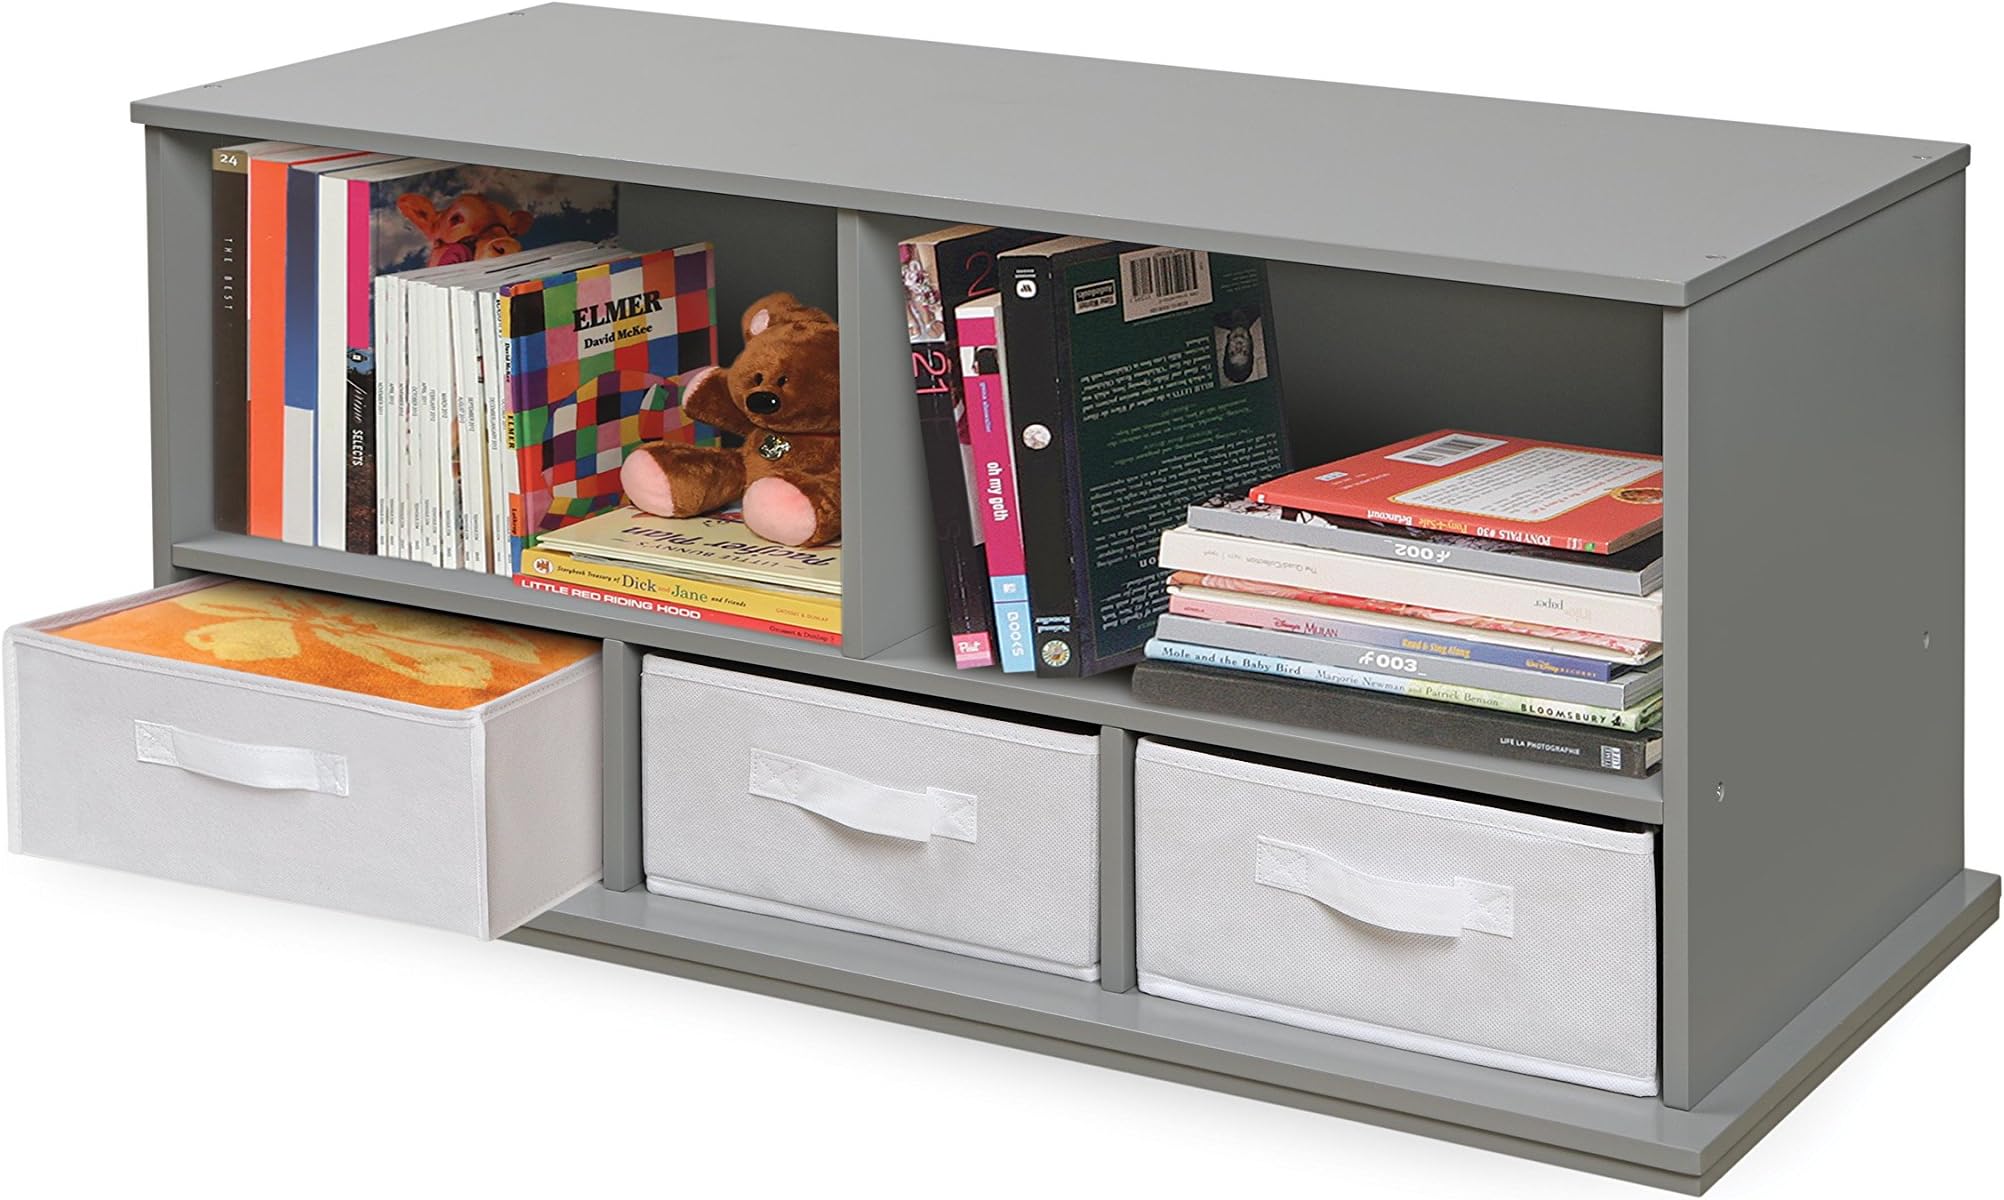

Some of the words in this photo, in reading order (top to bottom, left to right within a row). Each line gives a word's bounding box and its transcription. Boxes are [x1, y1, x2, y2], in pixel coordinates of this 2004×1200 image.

[220, 154, 238, 166] 24
[224, 238, 233, 262] THE
[224, 275, 233, 309] BEST
[572, 290, 662, 332] ELMER
[584, 330, 616, 349] David
[617, 324, 653, 342] McKee
[911, 350, 950, 396] 21
[352, 429, 363, 465] SELECTS
[986, 462, 1003, 476] oh
[987, 478, 1003, 496] my
[988, 496, 1009, 522] goth
[1367, 510, 1413, 526] Betancourt
[1476, 526, 1495, 537] #30
[1499, 529, 1522, 543] PALS
[1522, 531, 1551, 546] PONY
[718, 554, 778, 568] LITTLE
[1138, 556, 1156, 568] on
[622, 574, 657, 592] Dick
[671, 585, 708, 603] Jane
[521, 580, 569, 595] LITTLE
[571, 589, 601, 601] RED
[603, 594, 653, 610] RIDING
[657, 603, 701, 619] HOOD
[1304, 622, 1338, 637] MULAN
[1162, 647, 1190, 659] Mole
[1195, 653, 1216, 663] and
[1220, 656, 1238, 666] the
[1242, 659, 1271, 672] Baby
[1276, 663, 1302, 675] Bird
[1315, 669, 1359, 685] Marjorie
[1362, 676, 1405, 691] Newman
[1408, 686, 1423, 695] and
[1425, 686, 1460, 700] Patrick
[1464, 693, 1499, 707] Benson
[1521, 703, 1606, 723] BLOOMSBURY
[1526, 741, 1580, 755] PHOTOGRAPHIE
